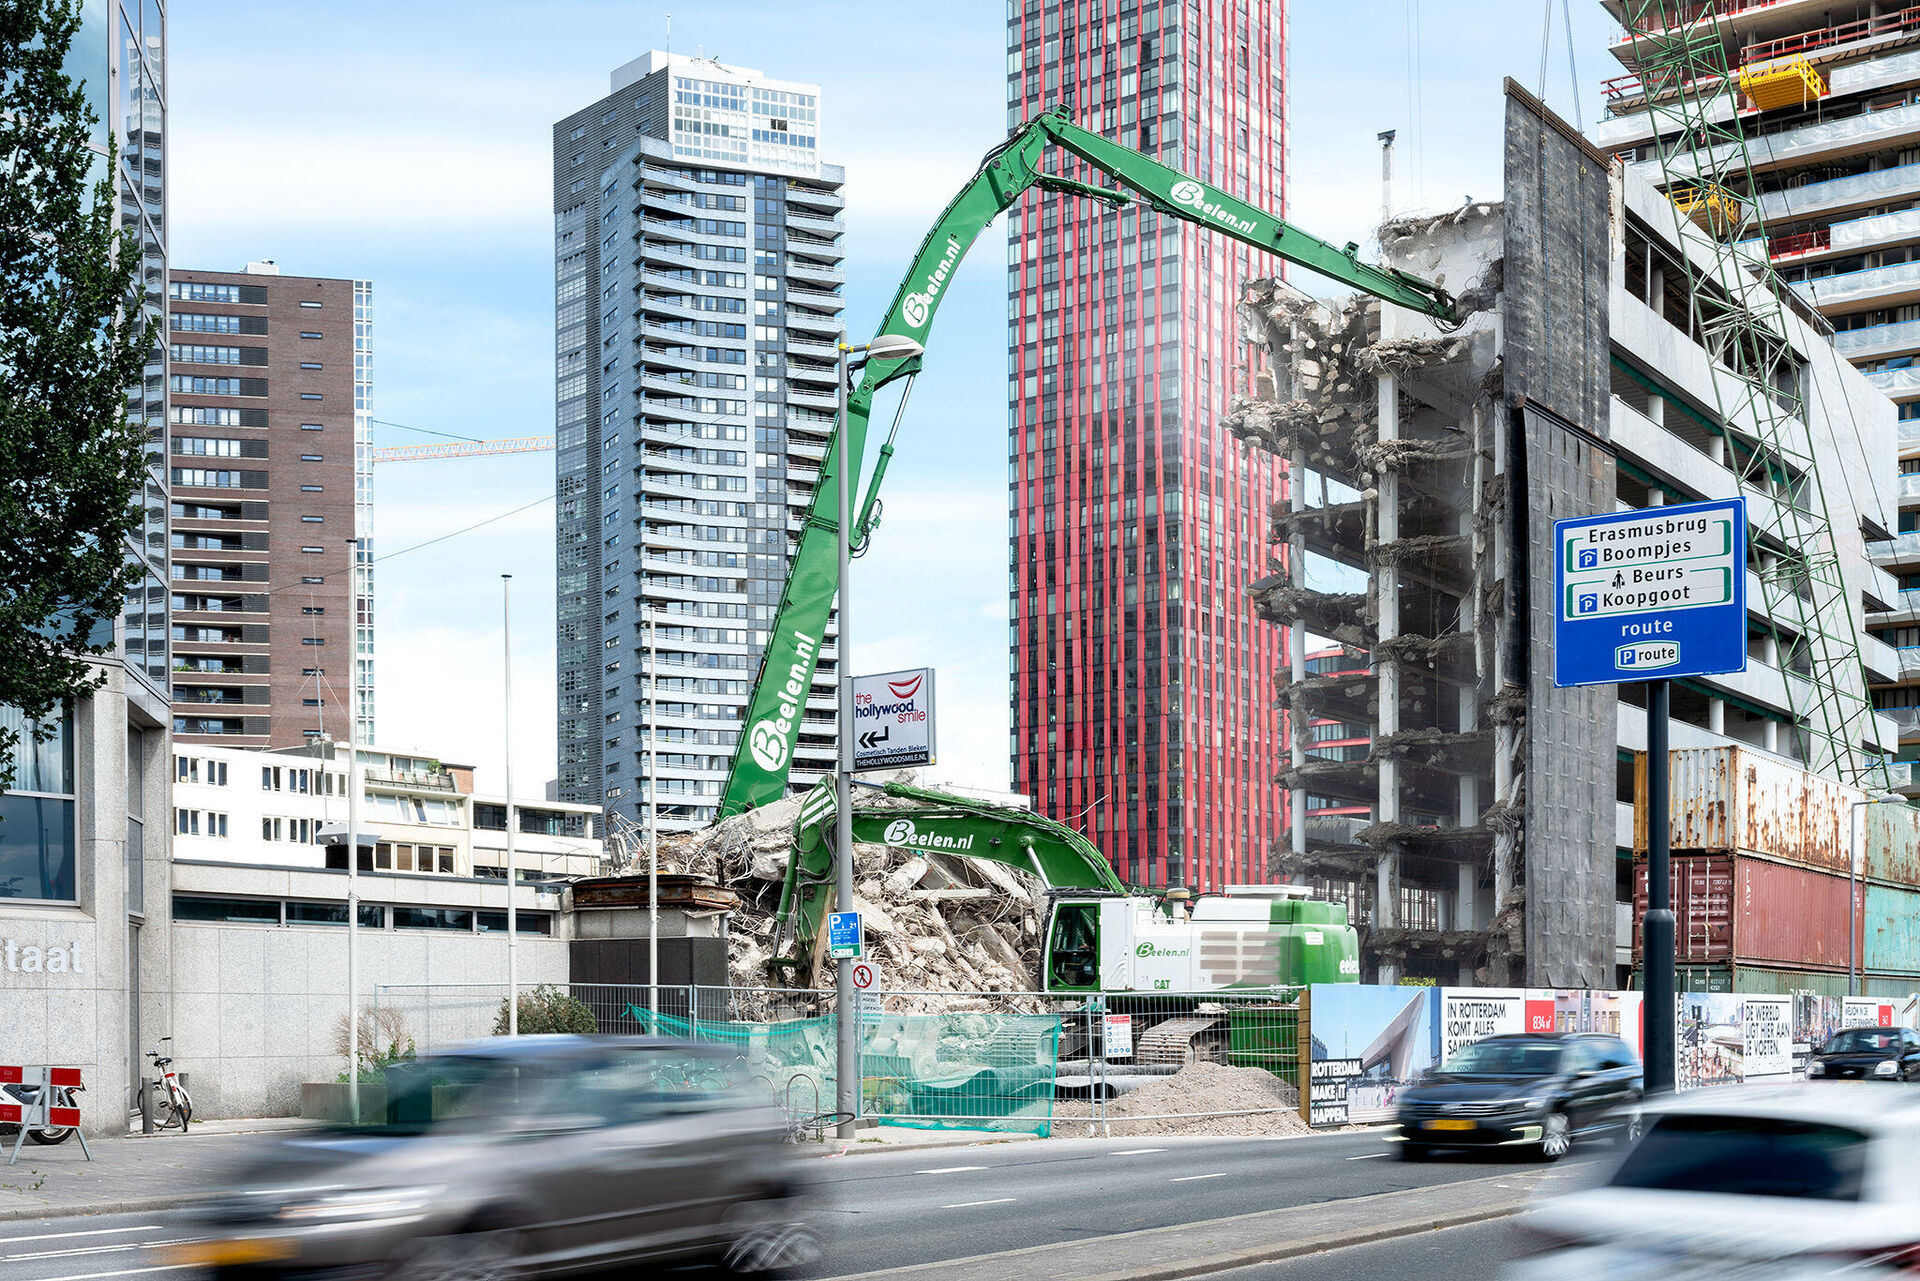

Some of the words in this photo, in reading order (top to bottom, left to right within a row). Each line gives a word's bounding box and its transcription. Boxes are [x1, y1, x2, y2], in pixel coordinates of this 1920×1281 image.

[1171, 181, 1257, 234] Beelen.nl
[903, 238, 961, 328] Beelen.nl
[1589, 518, 1707, 543] Erasmusbrug
[1603, 541, 1691, 562] Boompjes
[1633, 567, 1684, 583] Beurs
[1603, 586, 1690, 607] Koopgoot
[1622, 620, 1673, 637] route
[1638, 648, 1675, 661] route
[750, 631, 816, 771] Beelen.nl
[856, 692, 872, 705] the
[898, 709, 926, 723] smile
[856, 748, 886, 757] Cosmetisch
[887, 746, 908, 754] Tanden
[856, 754, 927, 766] THEHOLLYWOODSMILE.NL
[884, 819, 974, 849] Beelen.nl
[830, 915, 841, 930] P
[0, 940, 83, 973] taat
[1136, 942, 1190, 958] Beelen.nl
[1154, 979, 1170, 989] CAT
[1447, 1002, 1457, 1018] IN
[1460, 1003, 1506, 1018] ROTTERDAM
[1746, 1005, 1753, 1021] DE
[1755, 1005, 1780, 1021] WERELD
[1448, 1021, 1471, 1037] KOMT
[1474, 1021, 1495, 1035] ALLES
[1532, 1016, 1545, 1029] 834
[1746, 1022, 1759, 1038] LIGT
[1761, 1022, 1774, 1038] HIER
[1776, 1022, 1790, 1038] AAN
[1745, 1040, 1752, 1056] JE
[1754, 1040, 1780, 1056] VOETEN.
[1312, 1060, 1362, 1077] ROTTERDAM.
[1312, 1084, 1335, 1100] MAKE
[1338, 1084, 1346, 1099] IT
[1312, 1107, 1348, 1123] HAPPEN.
